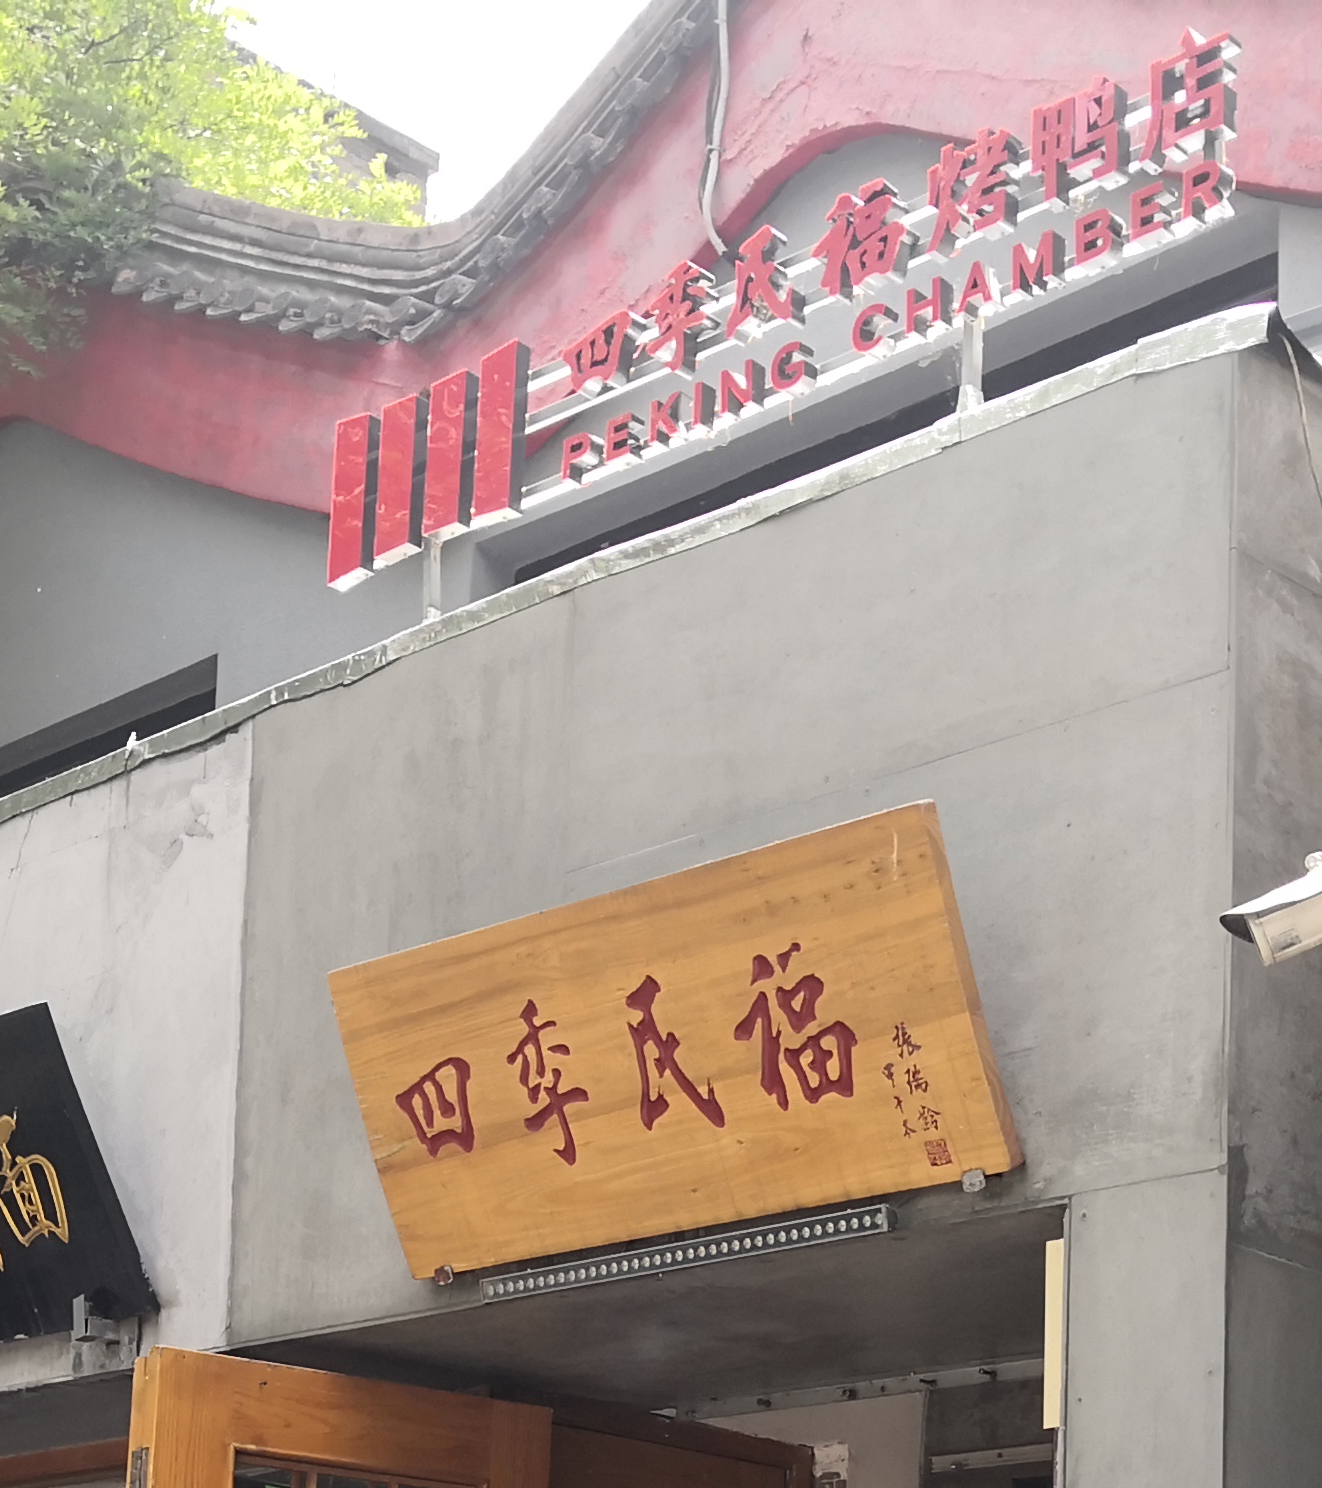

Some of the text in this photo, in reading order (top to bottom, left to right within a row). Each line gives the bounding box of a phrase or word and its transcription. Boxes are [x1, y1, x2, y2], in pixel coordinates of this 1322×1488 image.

[561, 160, 1223, 481] PEKING CHAMBER
[563, 27, 1235, 392] 四季民福烤鸭店
[396, 942, 858, 1166] 四季民福
